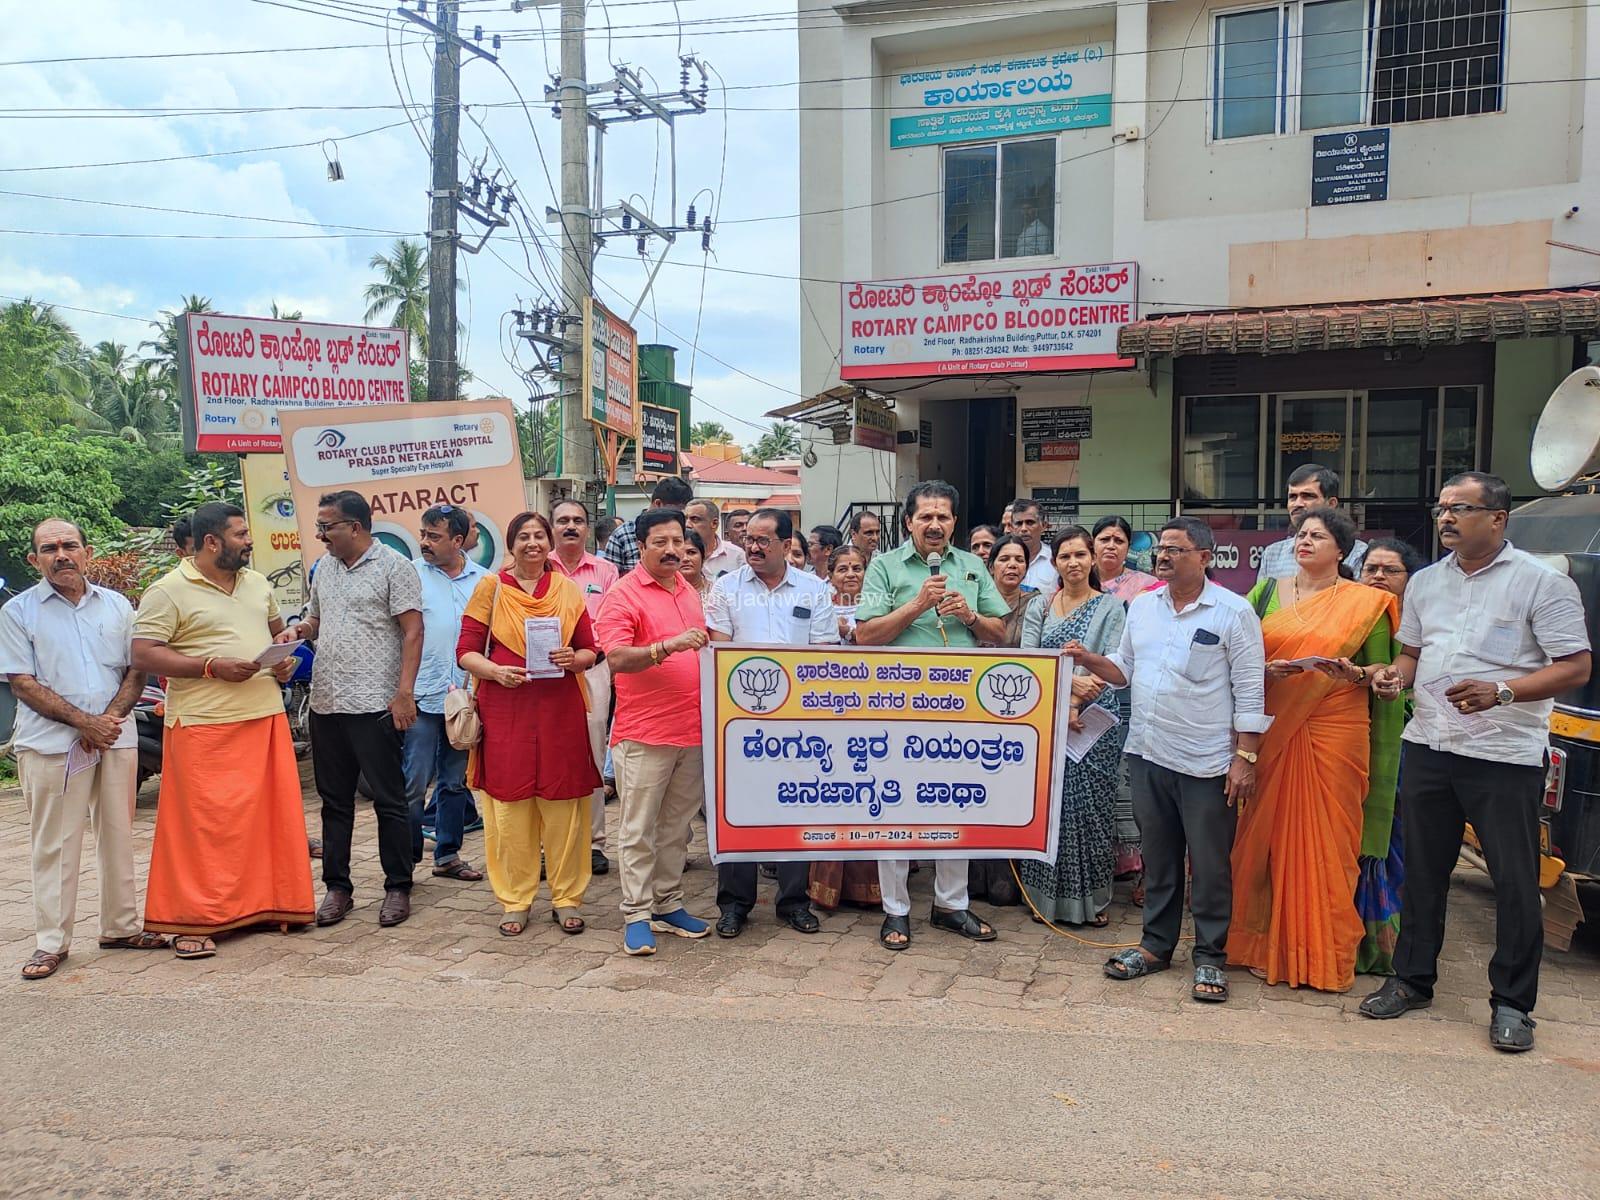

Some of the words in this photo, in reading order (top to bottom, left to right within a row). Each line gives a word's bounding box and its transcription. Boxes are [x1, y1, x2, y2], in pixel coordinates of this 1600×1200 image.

[924, 69, 1073, 106] ಕಾರ್ಯಾಲಯ
[1333, 185, 1366, 194] ADVOCATE
[849, 282, 915, 309] ರೋಟರಿ
[1012, 272, 1052, 307] ಬ್ಲಡ್
[1060, 268, 1129, 297] ಸೆಂಟರ್
[852, 317, 917, 338] ROTARY
[924, 311, 998, 334] CAMPCO
[1005, 307, 1067, 330] BLOOD
[1069, 303, 1130, 325] CENTRE
[197, 321, 255, 358] ರೋಟರಿ
[327, 335, 353, 375] ಬ್ಲಡ್
[357, 334, 401, 367] ಸೆಂಟರ್
[923, 338, 936, 346] 2nd
[959, 334, 1005, 345] Radhakrishna
[1077, 329, 1102, 338] 574201
[854, 344, 885, 356] Rotary
[969, 361, 989, 371] Rotary
[990, 360, 1005, 369] Club
[202, 372, 258, 397] ROTARY
[262, 374, 320, 400] CAMPCO
[323, 377, 366, 401] BLOOD
[368, 379, 405, 403] CENTRE
[207, 396, 222, 405] 2nd
[251, 398, 302, 407] Radhakrishna
[205, 414, 237, 425] Rotary
[453, 422, 479, 433] Rotary
[237, 439, 252, 448] Unit
[252, 439, 260, 448] of
[261, 440, 282, 450] Rotary
[318, 447, 358, 461] ROTARY
[361, 444, 387, 457] CLUB
[389, 441, 428, 454] PUTTUR
[430, 439, 448, 451] EYE
[450, 435, 493, 448] HOSPITAL
[348, 455, 396, 469] PRASAD
[399, 448, 463, 464] NETRALAYA
[371, 467, 389, 477] Super
[390, 464, 417, 475] Specialty
[418, 462, 429, 472] Eye
[430, 460, 454, 471] Hospital
[371, 482, 479, 516] ATARACT
[796, 662, 869, 683] ಭಾರತೀಯ
[876, 662, 922, 682] ಜನತಾ
[928, 666, 973, 683] ಪಾರ್ಟಿ
[802, 693, 861, 714] ಪುತ್ತೂರು
[868, 692, 905, 710] ನಗರ
[912, 693, 965, 711] ಮಂಡಲ
[743, 728, 833, 773] ಡೆಂಗ್ಯೂ
[847, 729, 888, 773] ಜ್ವರ
[904, 732, 1024, 771] ನಿಯಂತ್ರಣ
[777, 776, 902, 816] ಜನಜಾಗೃತಿ
[916, 779, 987, 809] ಜಾಥಾ
[802, 830, 837, 842] ದಿನಾಂಕ
[849, 830, 913, 840] 10-07-2024
[918, 829, 961, 842] ಬುಧವಾರ
